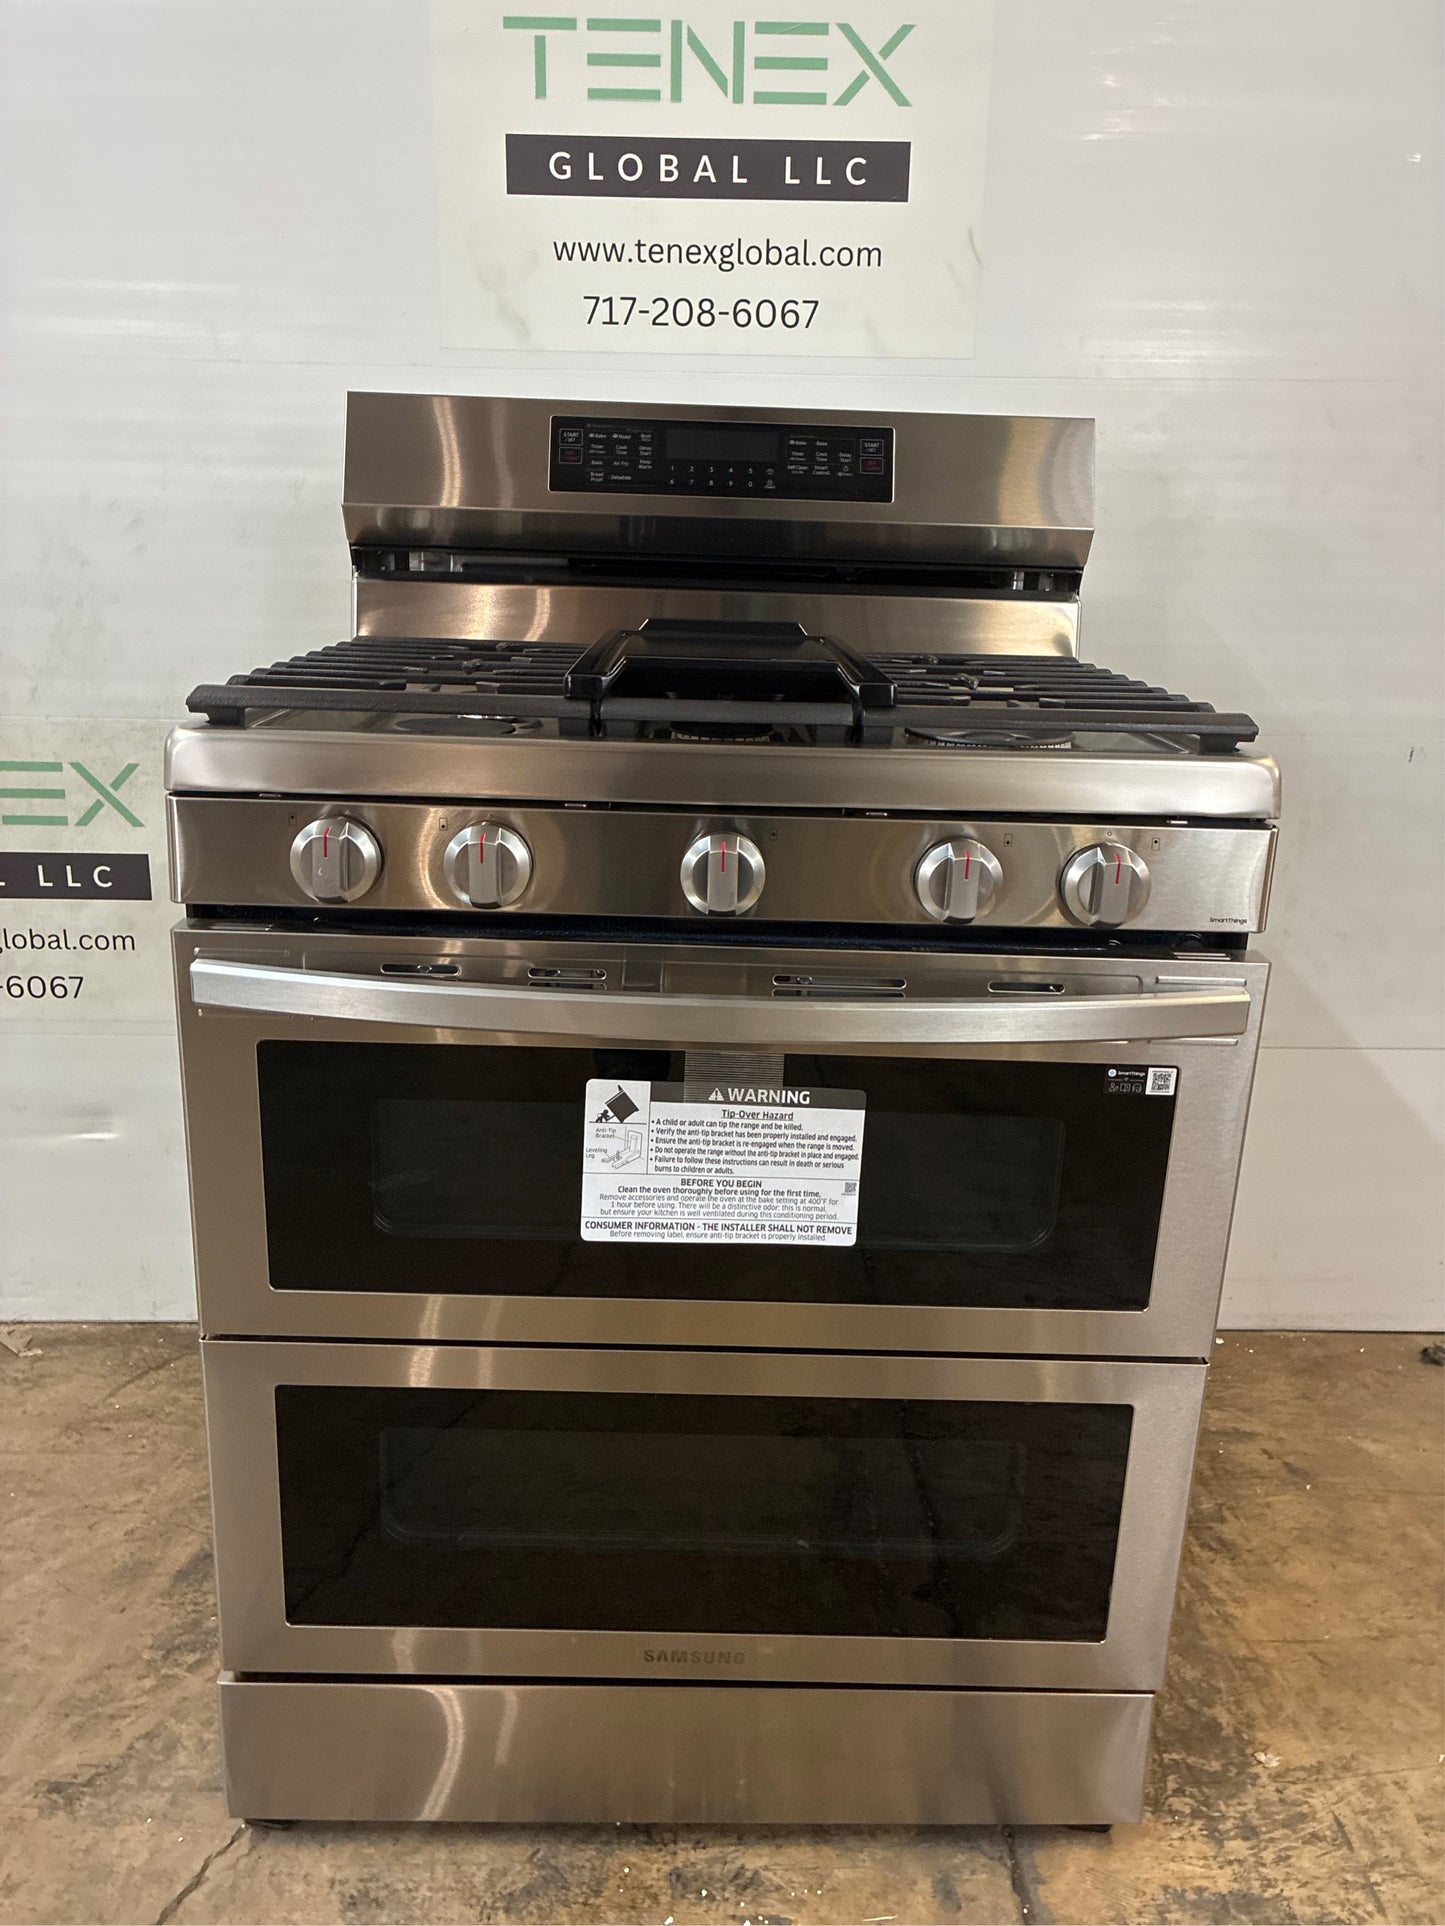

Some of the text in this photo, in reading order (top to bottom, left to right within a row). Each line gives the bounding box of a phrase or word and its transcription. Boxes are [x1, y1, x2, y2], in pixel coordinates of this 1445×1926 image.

[503, 16, 916, 107] TENEX
[549, 151, 868, 186] GLOBAL LLC
[553, 238, 882, 272] www.tenexglobal.com
[583, 296, 820, 329] 717-208-6067
[38, 864, 113, 888] LLC
[0, 928, 136, 953] lobal.com
[728, 1088, 810, 1104] WARNING
[722, 1109, 794, 1119] Tip-Over Hazard
[656, 1128, 675, 1136] Verify
[687, 1129, 710, 1137] anti-tip
[763, 1132, 789, 1140] properly
[830, 1134, 857, 1143] engaged.
[688, 1138, 711, 1146] anti-tip
[742, 1140, 777, 1149] re-engaged
[674, 1147, 696, 1155] operate
[758, 1150, 778, 1158] anti-tip
[834, 1153, 859, 1161] engaged.
[681, 1178, 714, 1186] BEFORE
[672, 1187, 713, 1196] thoroughly
[740, 1189, 759, 1197] using
[680, 1195, 706, 1203] operate
[737, 1211, 758, 1219] during
[774, 1212, 814, 1220] conditioning
[585, 1221, 633, 1229] CONSUMER
[635, 1222, 695, 1231] INFORMATION
[721, 1224, 766, 1232] INSTALLER
[816, 1226, 852, 1234] REMOVE
[634, 1230, 665, 1238] removing
[708, 1232, 734, 1240] anti-tip
[768, 1234, 796, 1242] properly
[644, 1649, 744, 1664] SAMSUNG
